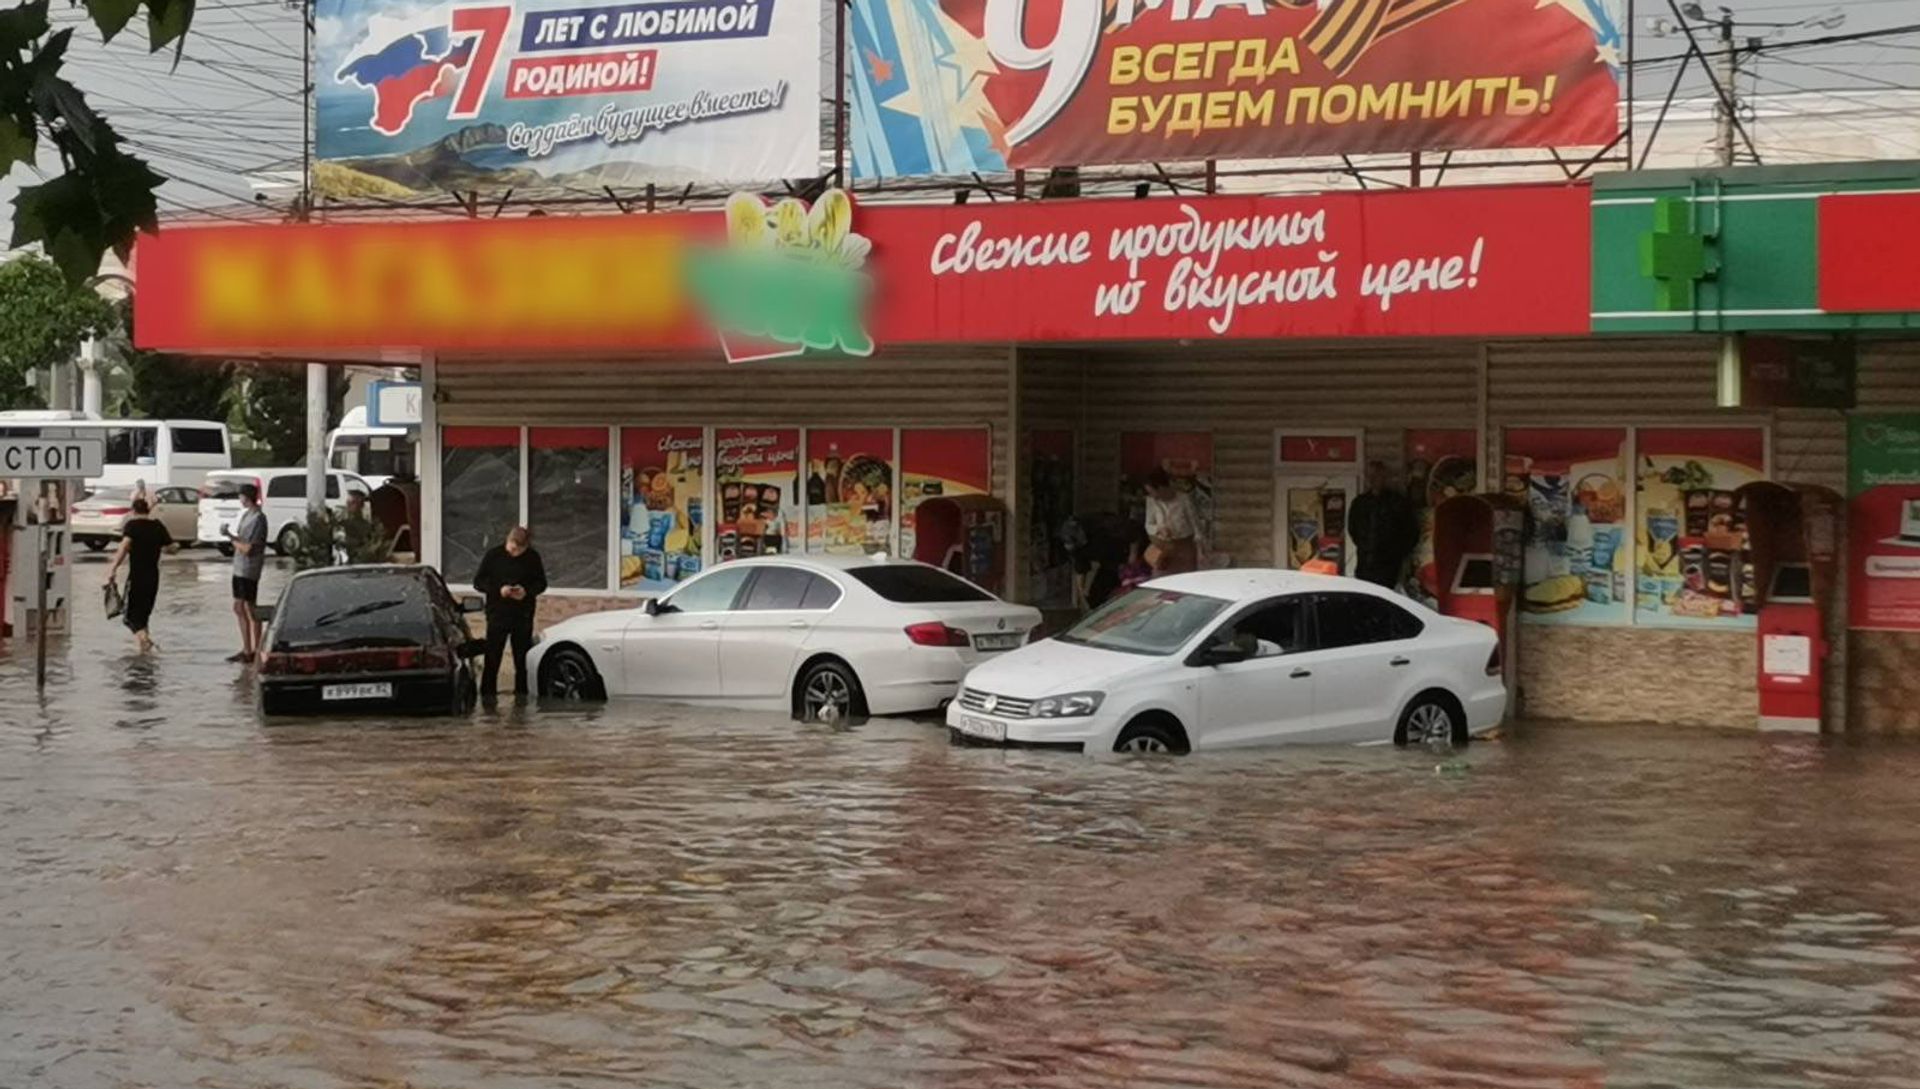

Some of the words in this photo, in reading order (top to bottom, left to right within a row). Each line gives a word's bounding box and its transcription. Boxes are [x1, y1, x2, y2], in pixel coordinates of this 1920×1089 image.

[535, 13, 586, 44] ЛЕТ
[590, 14, 608, 38] С
[612, 0, 758, 38] ЛЮБИМОЙ
[448, 6, 512, 118] 7
[512, 54, 650, 96] РОДИНОЙ!
[984, 0, 1101, 148] 9
[1109, 36, 1301, 87] ВСЕГДА
[508, 113, 595, 157] Создаём
[595, 102, 687, 145] будущее
[690, 79, 788, 119] вместе!
[1106, 88, 1274, 140] БУДЕМ
[1285, 75, 1557, 127] ПОМНИТЬ!
[930, 219, 1091, 276] Свежие
[1108, 204, 1326, 282] продукты
[1094, 277, 1148, 317] по
[1163, 250, 1339, 335] вкусной
[1360, 236, 1485, 312] цене!
[4, 445, 82, 471] СТОП
